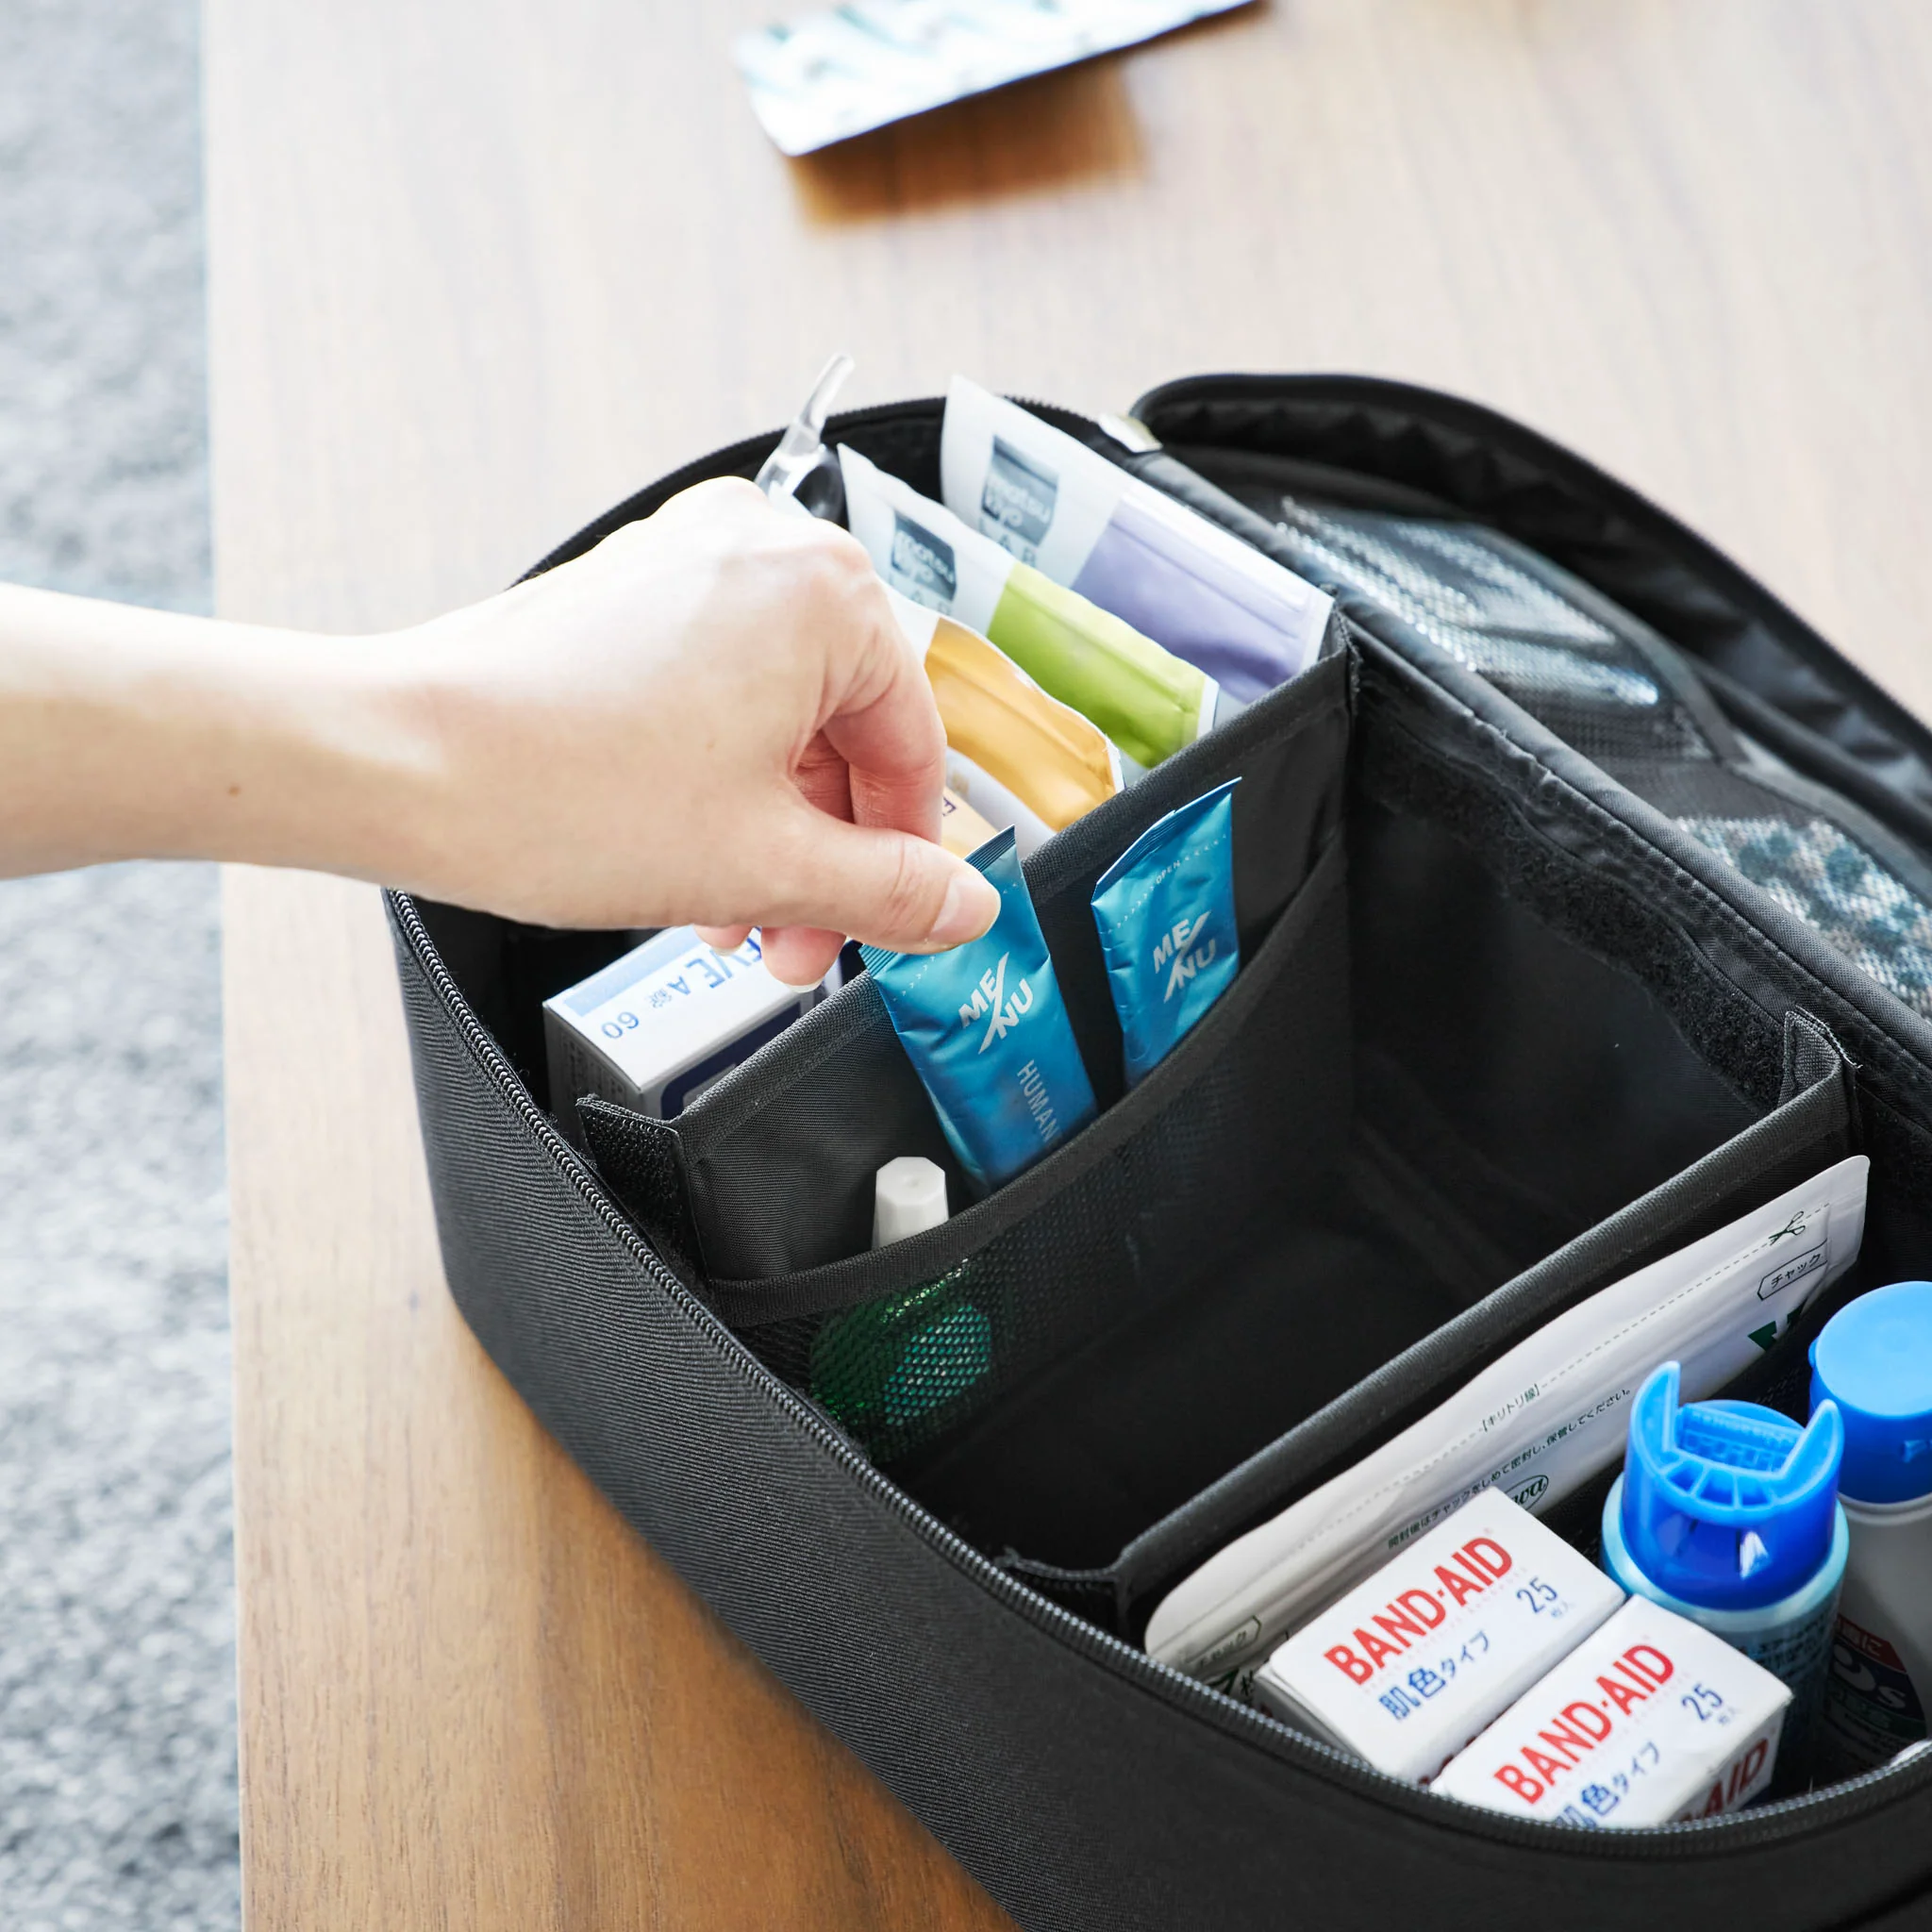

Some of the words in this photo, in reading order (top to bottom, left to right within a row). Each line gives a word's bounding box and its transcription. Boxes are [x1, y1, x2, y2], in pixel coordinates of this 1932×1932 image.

[601, 1010, 640, 1040] 60
[1017, 1059, 1060, 1142] HUMAN
[1771, 1253, 1822, 1289] チャック
[1516, 1575, 1558, 1614] 25
[1680, 1682, 1724, 1722] 25
